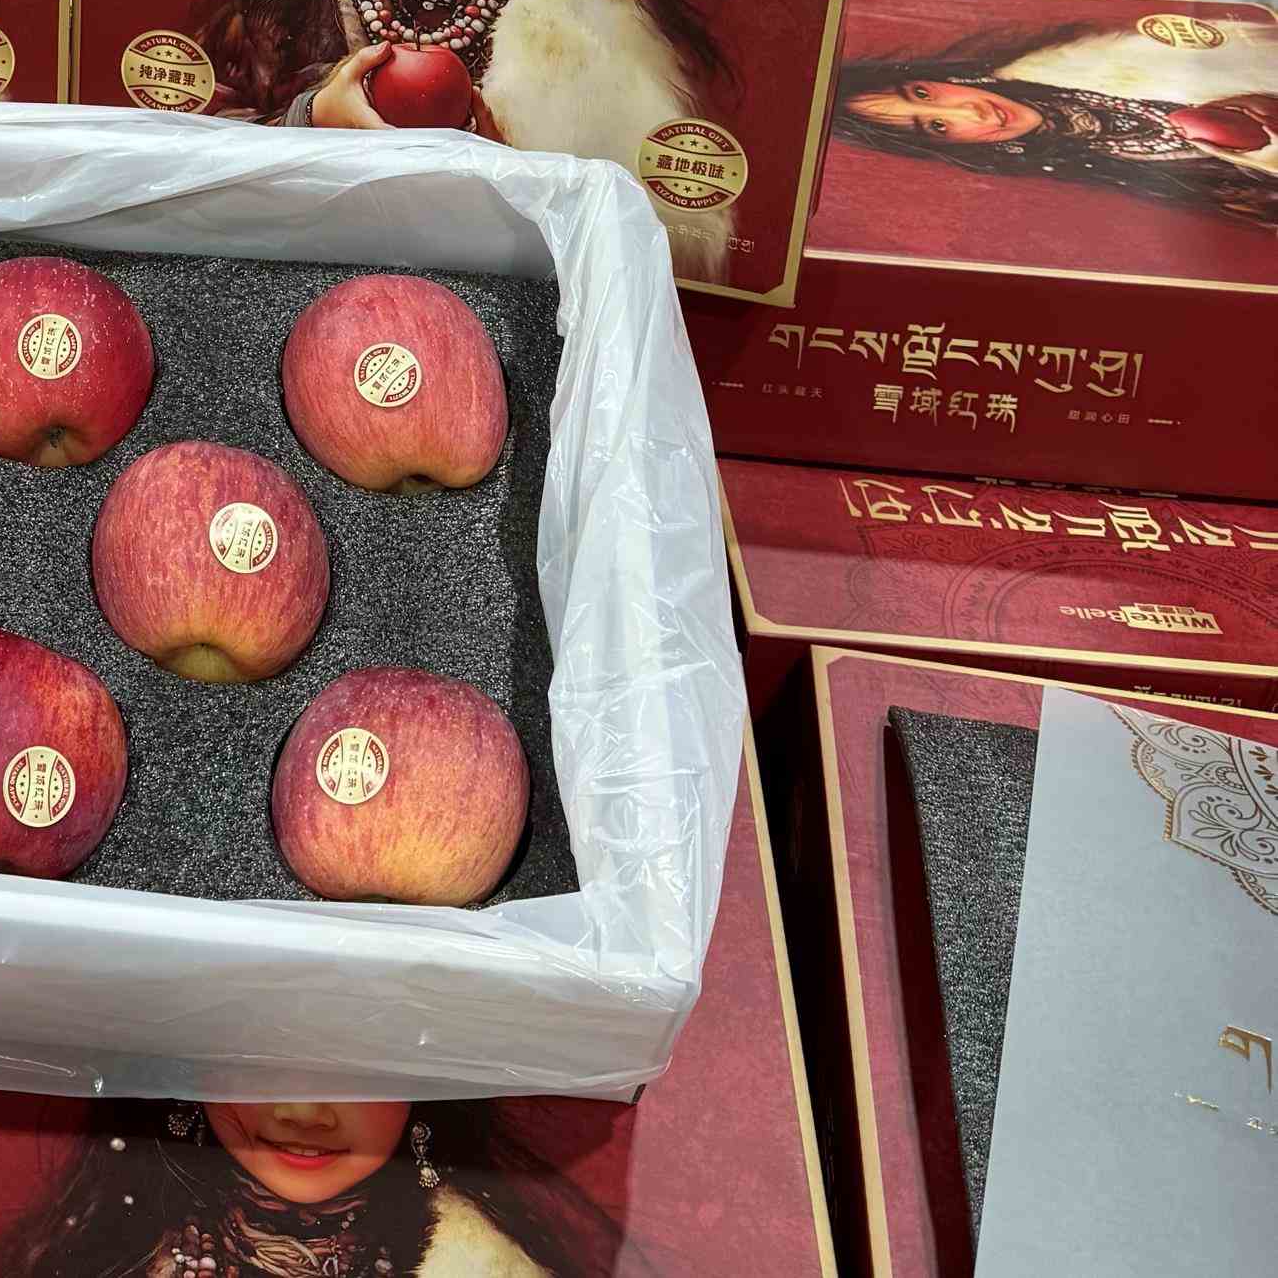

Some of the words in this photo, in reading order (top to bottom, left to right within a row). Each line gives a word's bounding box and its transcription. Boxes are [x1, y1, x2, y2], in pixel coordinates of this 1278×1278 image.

[656, 154, 725, 180] 藏地极味
[873, 383, 1018, 433] 雪域红珠
